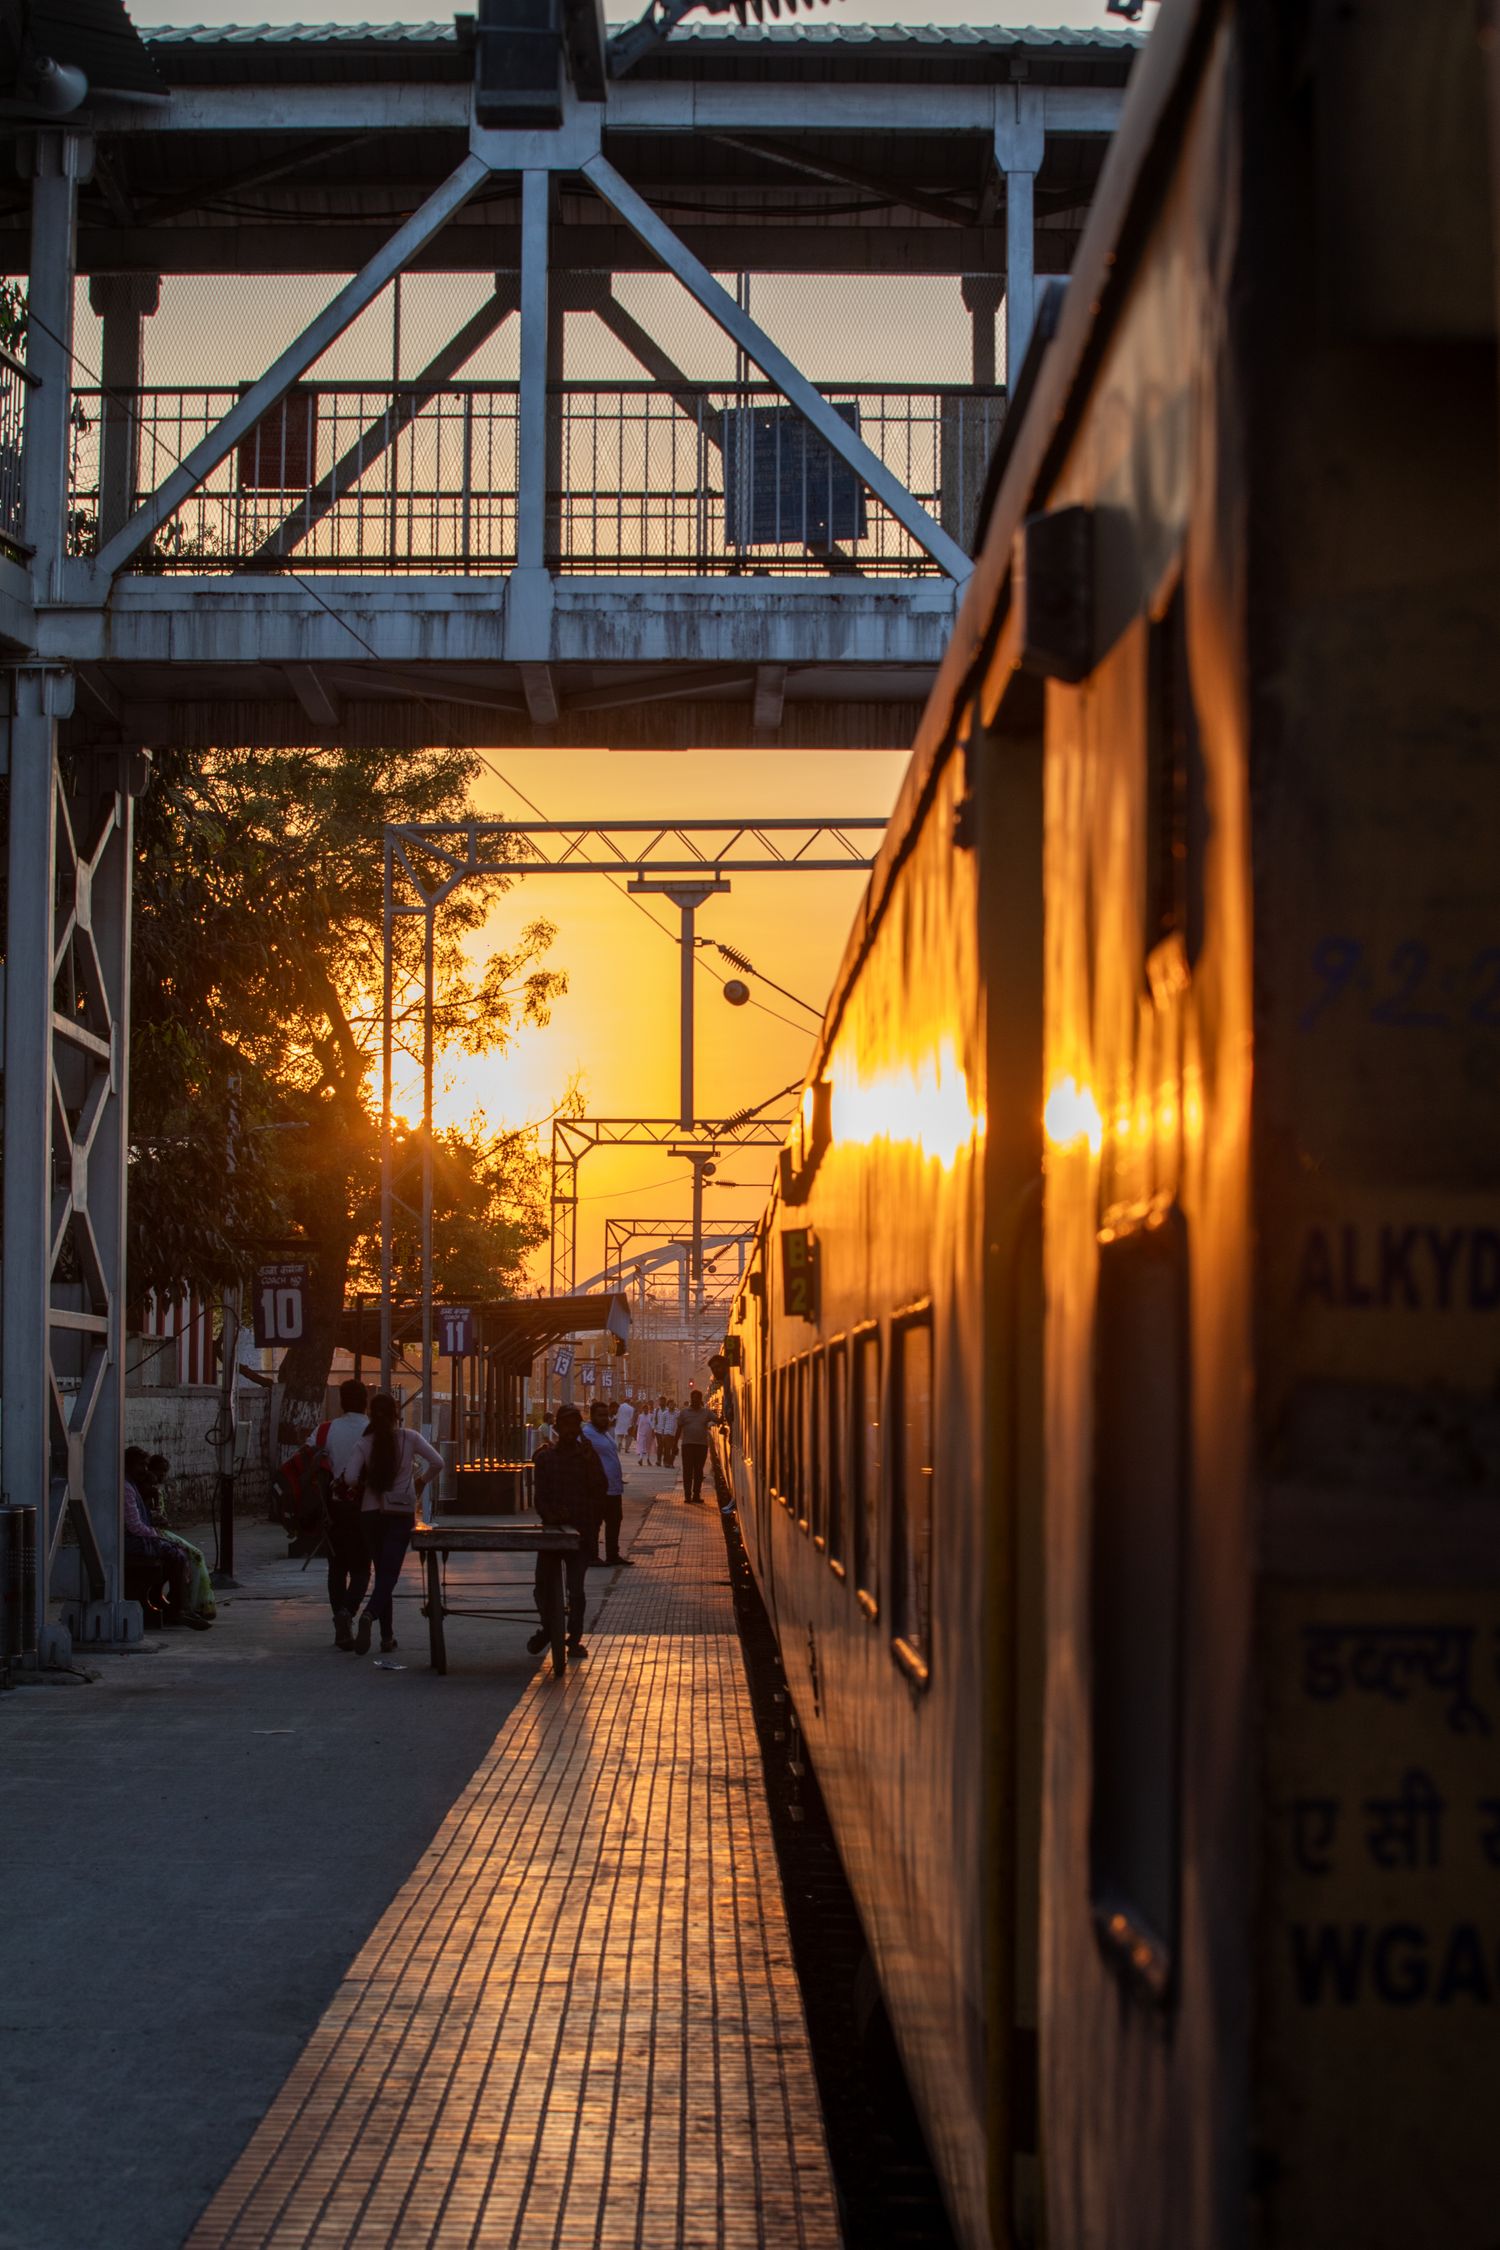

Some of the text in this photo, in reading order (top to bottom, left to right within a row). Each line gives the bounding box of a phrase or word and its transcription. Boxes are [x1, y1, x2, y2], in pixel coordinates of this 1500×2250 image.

[261, 1288, 303, 1339] 10
[446, 1322, 464, 1351] 11
[555, 1356, 570, 1376] 13
[582, 1370, 595, 1384] 14
[602, 1374, 612, 1387] 15
[1294, 1922, 1500, 2004] WGA
